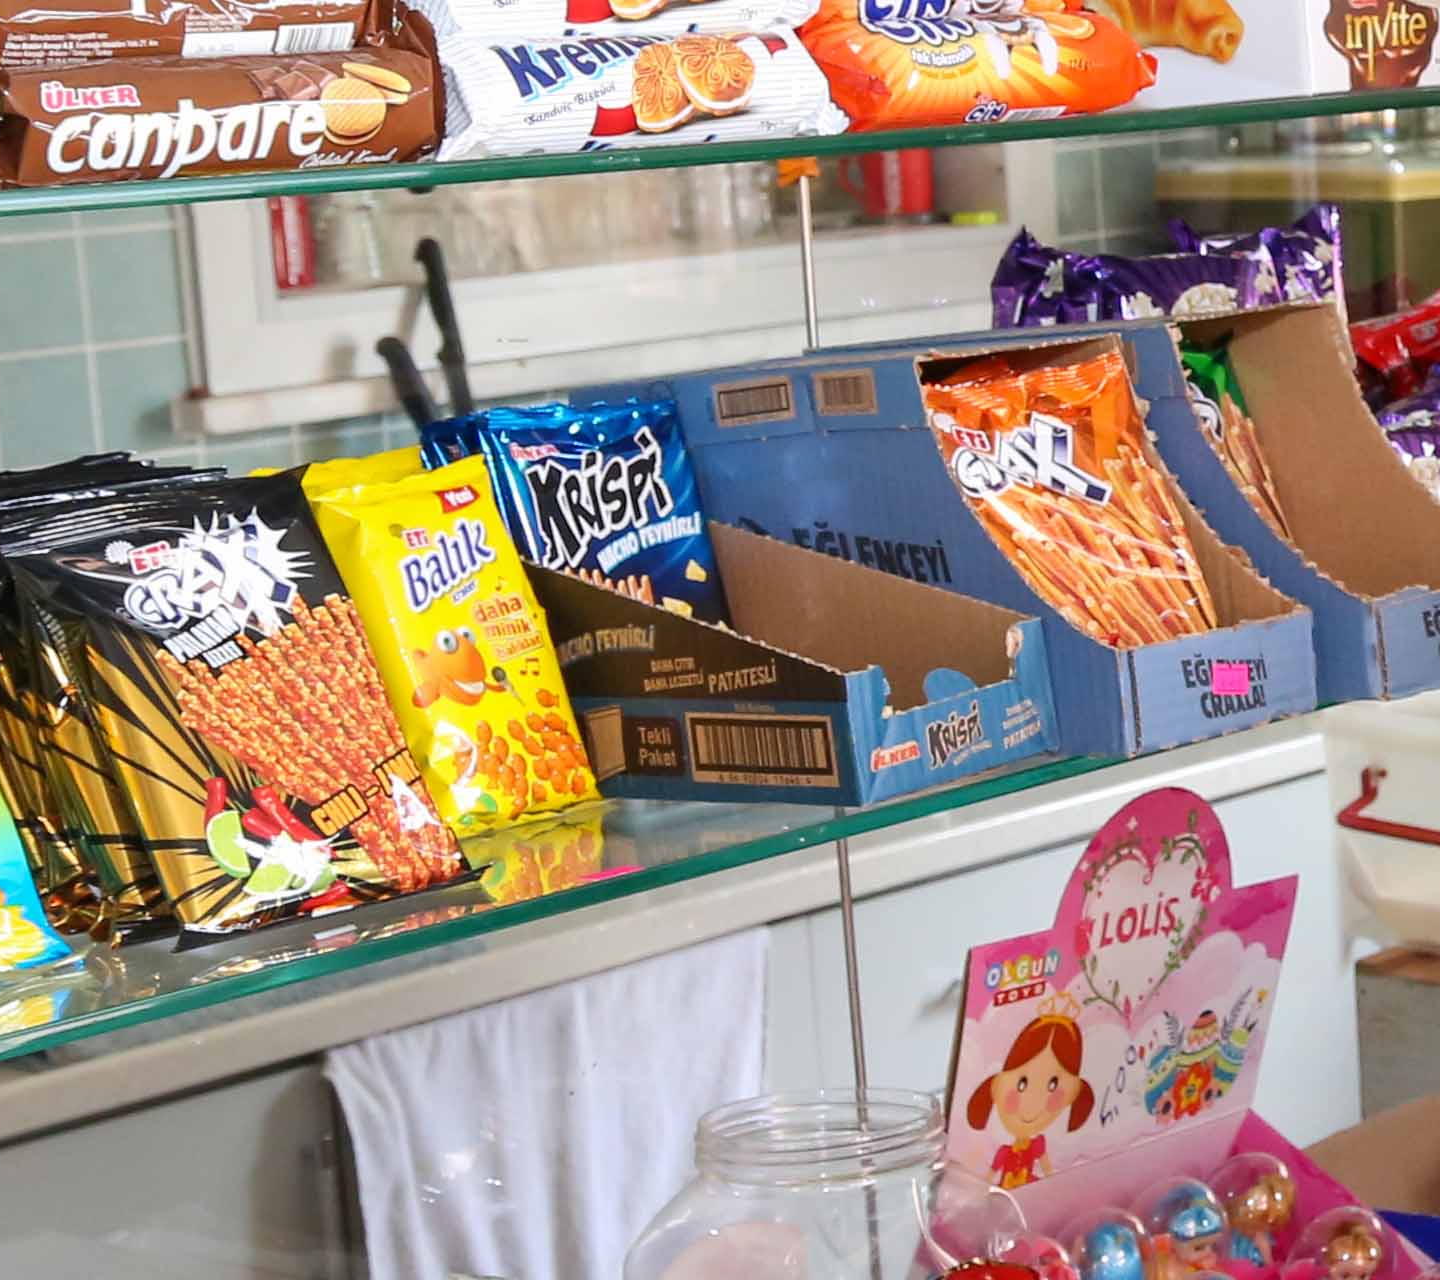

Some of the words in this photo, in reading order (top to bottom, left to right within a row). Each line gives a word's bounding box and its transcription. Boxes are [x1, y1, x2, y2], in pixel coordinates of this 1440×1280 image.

[42, 80, 139, 111] ÜLKER
[47, 97, 327, 179] canpare
[637, 726, 672, 747] Tekli
[639, 748, 677, 769] Paket
[985, 951, 1060, 989] OLGUN
[995, 982, 1046, 1006] TOYS
